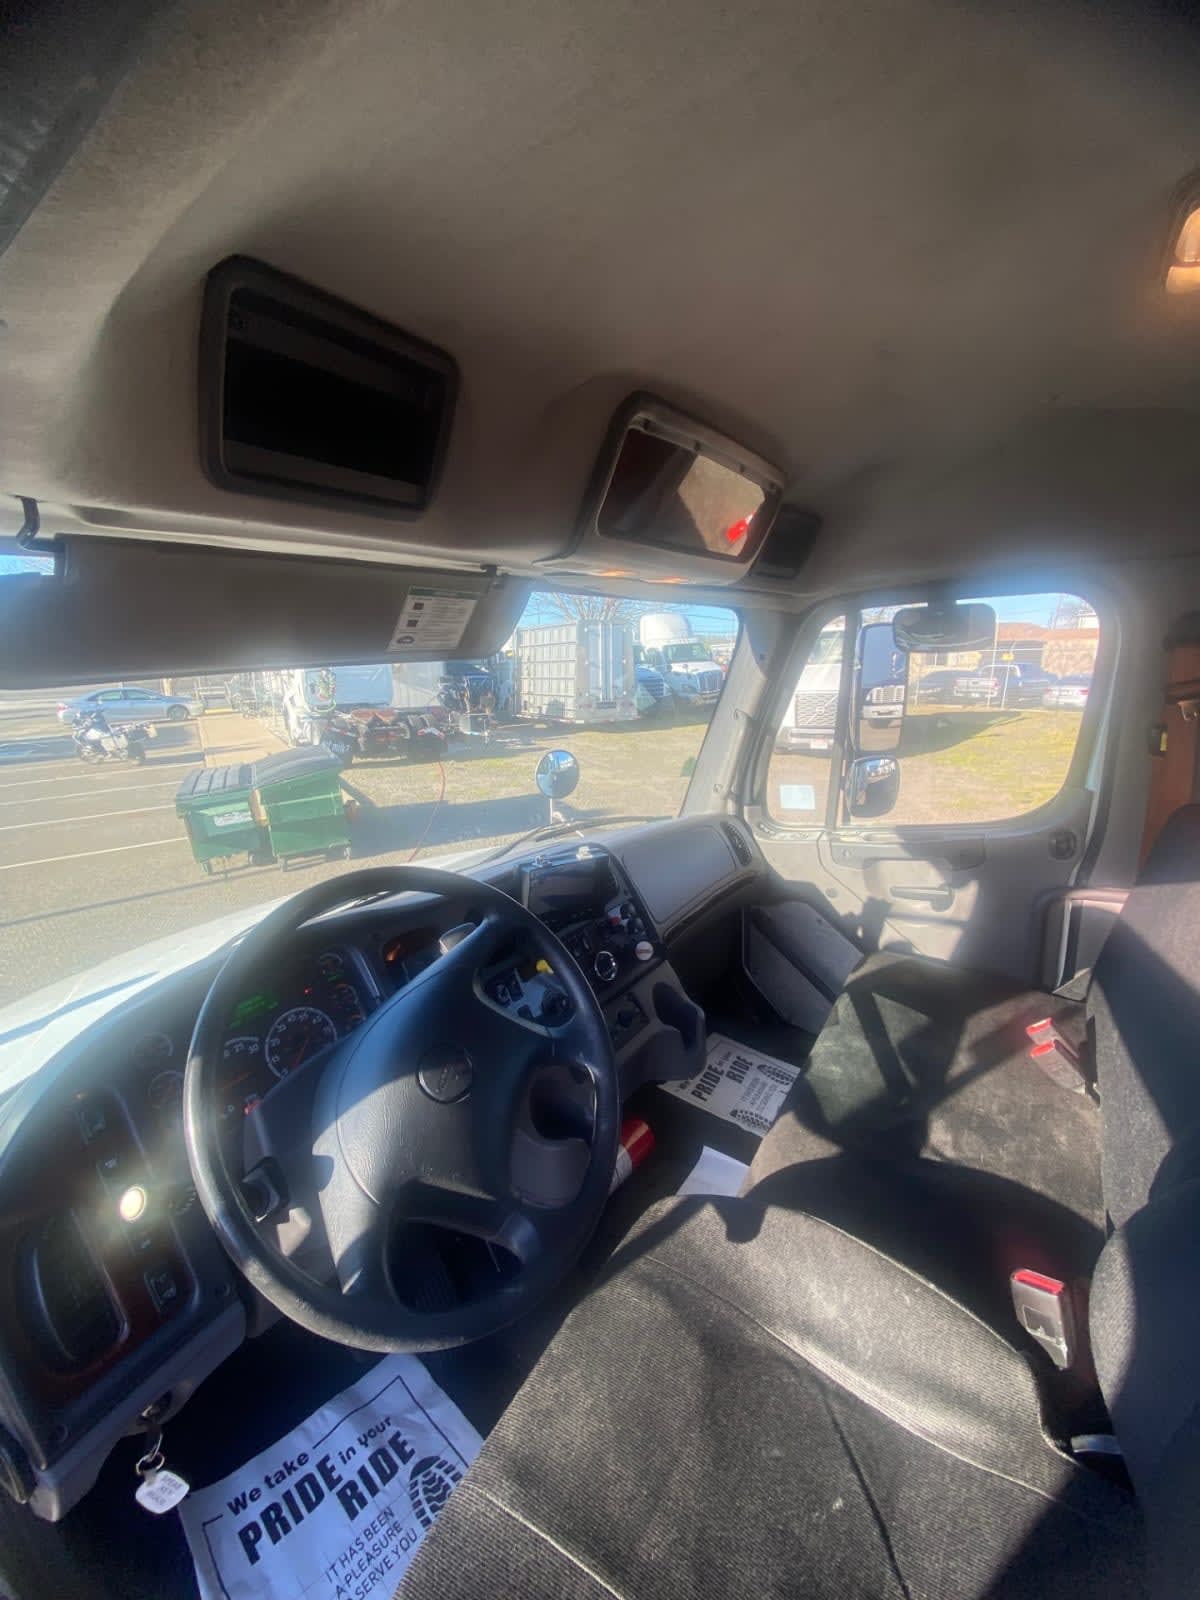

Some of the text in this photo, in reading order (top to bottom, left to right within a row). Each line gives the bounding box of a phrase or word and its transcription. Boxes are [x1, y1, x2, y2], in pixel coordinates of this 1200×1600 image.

[691, 1064, 725, 1102] PRIDE
[725, 1055, 753, 1085] RIDE
[227, 1451, 310, 1517] We take
[238, 1416, 393, 1567] PRIDE in your
[335, 1431, 416, 1521] RIDE
[325, 1505, 395, 1584] IT HAS BEEN
[336, 1521, 403, 1600] A PLEASURE
[355, 1527, 418, 1600] SERVE YOU
